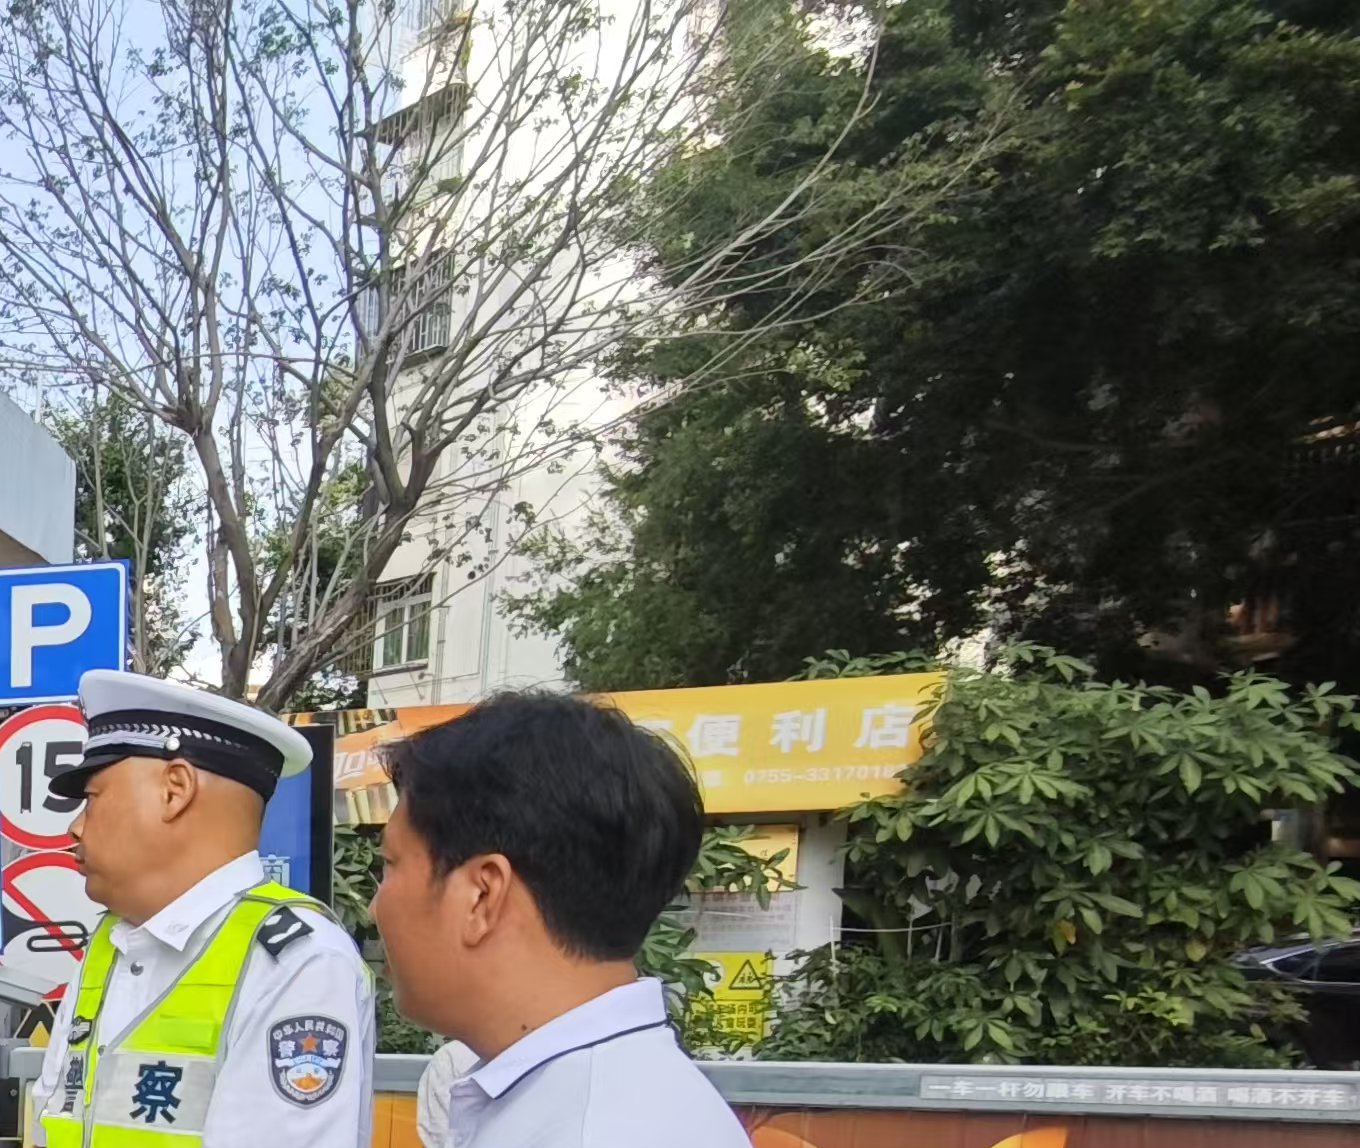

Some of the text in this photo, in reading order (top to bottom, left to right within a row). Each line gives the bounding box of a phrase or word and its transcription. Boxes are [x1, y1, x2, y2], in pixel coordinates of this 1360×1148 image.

[10, 582, 92, 688] P
[633, 703, 917, 757] 便利店
[15, 741, 85, 813] 15
[129, 1060, 184, 1124] 察
[1106, 1084, 1217, 1103] 开车不喝酒
[1228, 1087, 1345, 1105] 喝酒不开车
